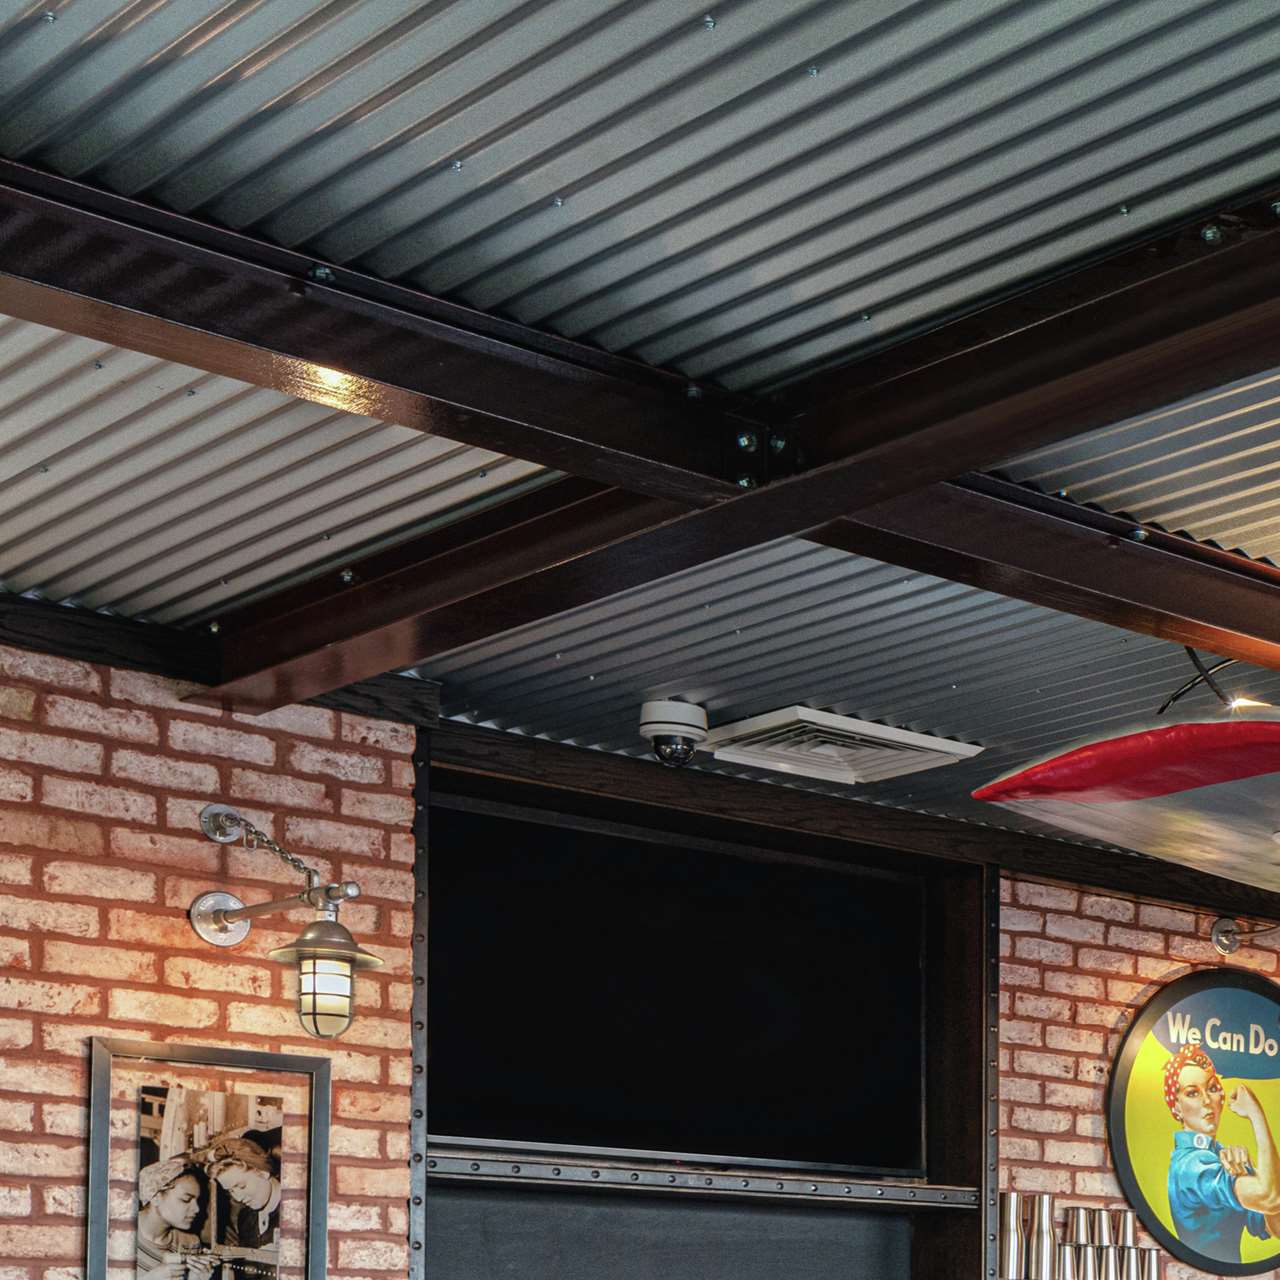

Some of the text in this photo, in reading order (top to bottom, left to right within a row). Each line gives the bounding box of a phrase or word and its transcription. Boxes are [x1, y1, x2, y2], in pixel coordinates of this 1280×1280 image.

[1167, 1011, 1202, 1045] We
[1205, 1018, 1245, 1053] Can
[1249, 1023, 1279, 1057] Do
